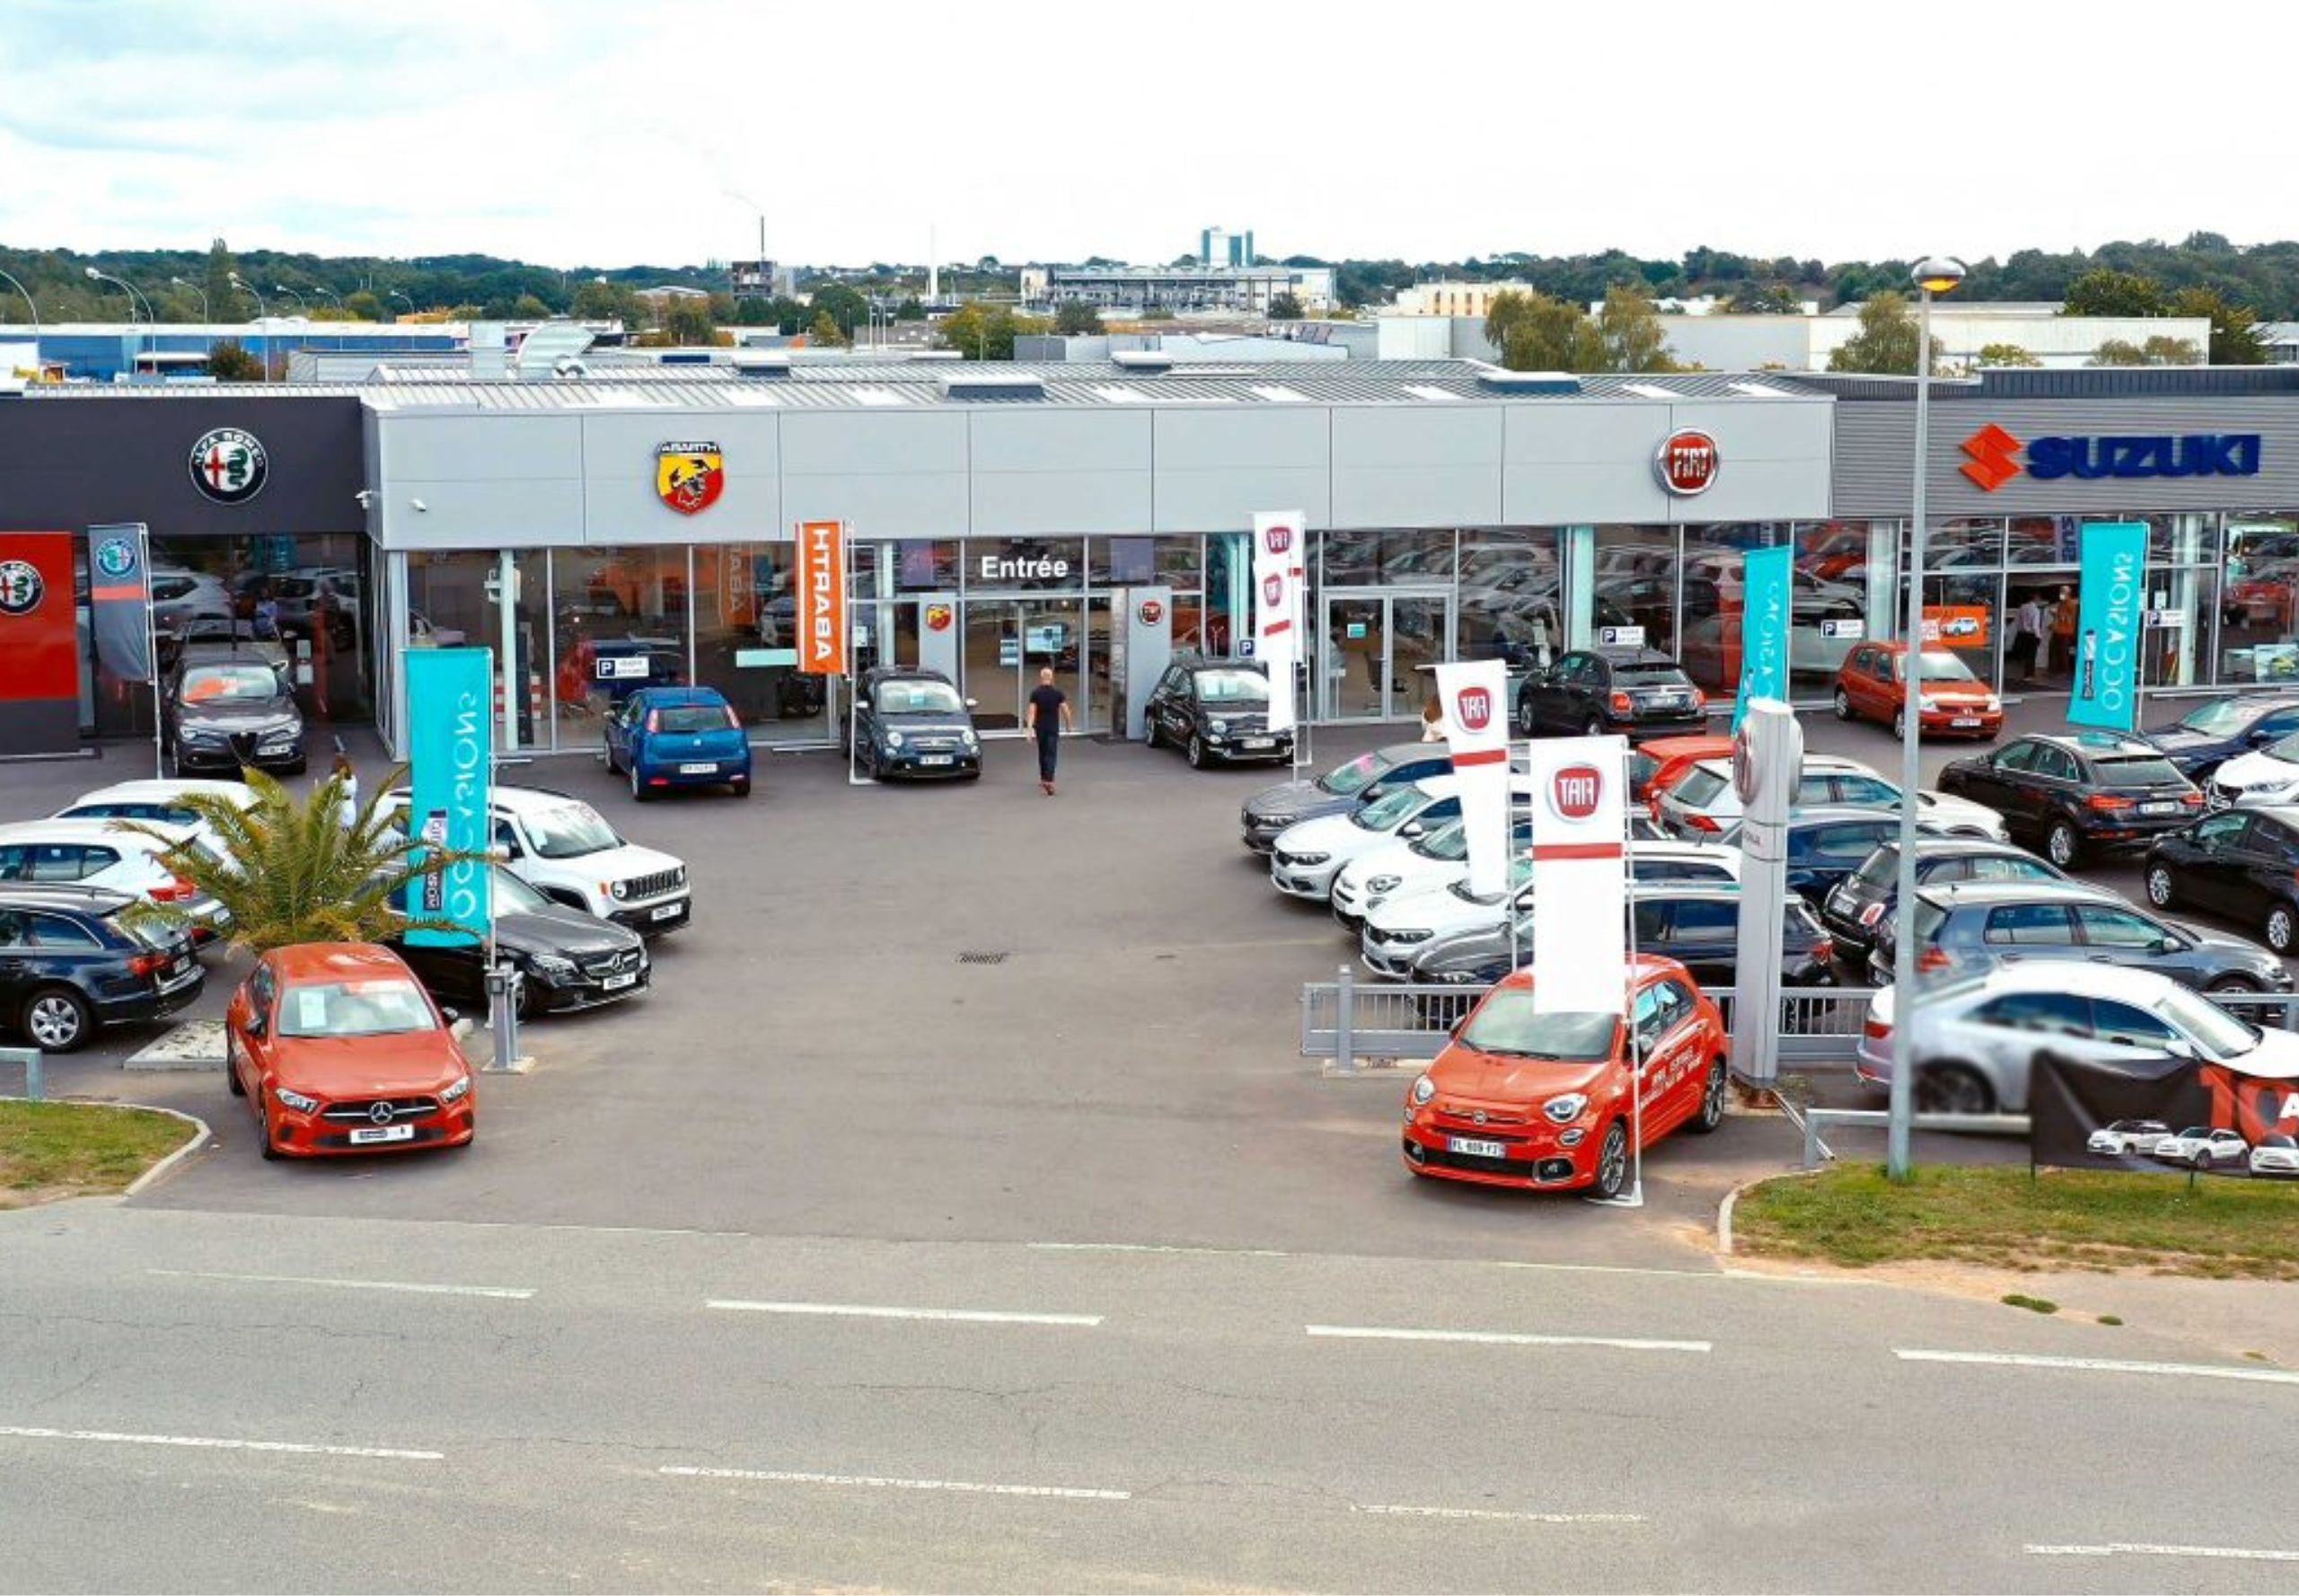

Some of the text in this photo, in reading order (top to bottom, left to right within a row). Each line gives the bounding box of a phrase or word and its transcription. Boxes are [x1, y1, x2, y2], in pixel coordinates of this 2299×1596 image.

[661, 442, 718, 452] ABARTH
[1673, 448, 1709, 478] FIAT
[2027, 435, 2261, 481] SUZUKI
[982, 554, 1069, 578] Entrée
[1242, 642, 1251, 654] P
[601, 662, 612, 675] P
